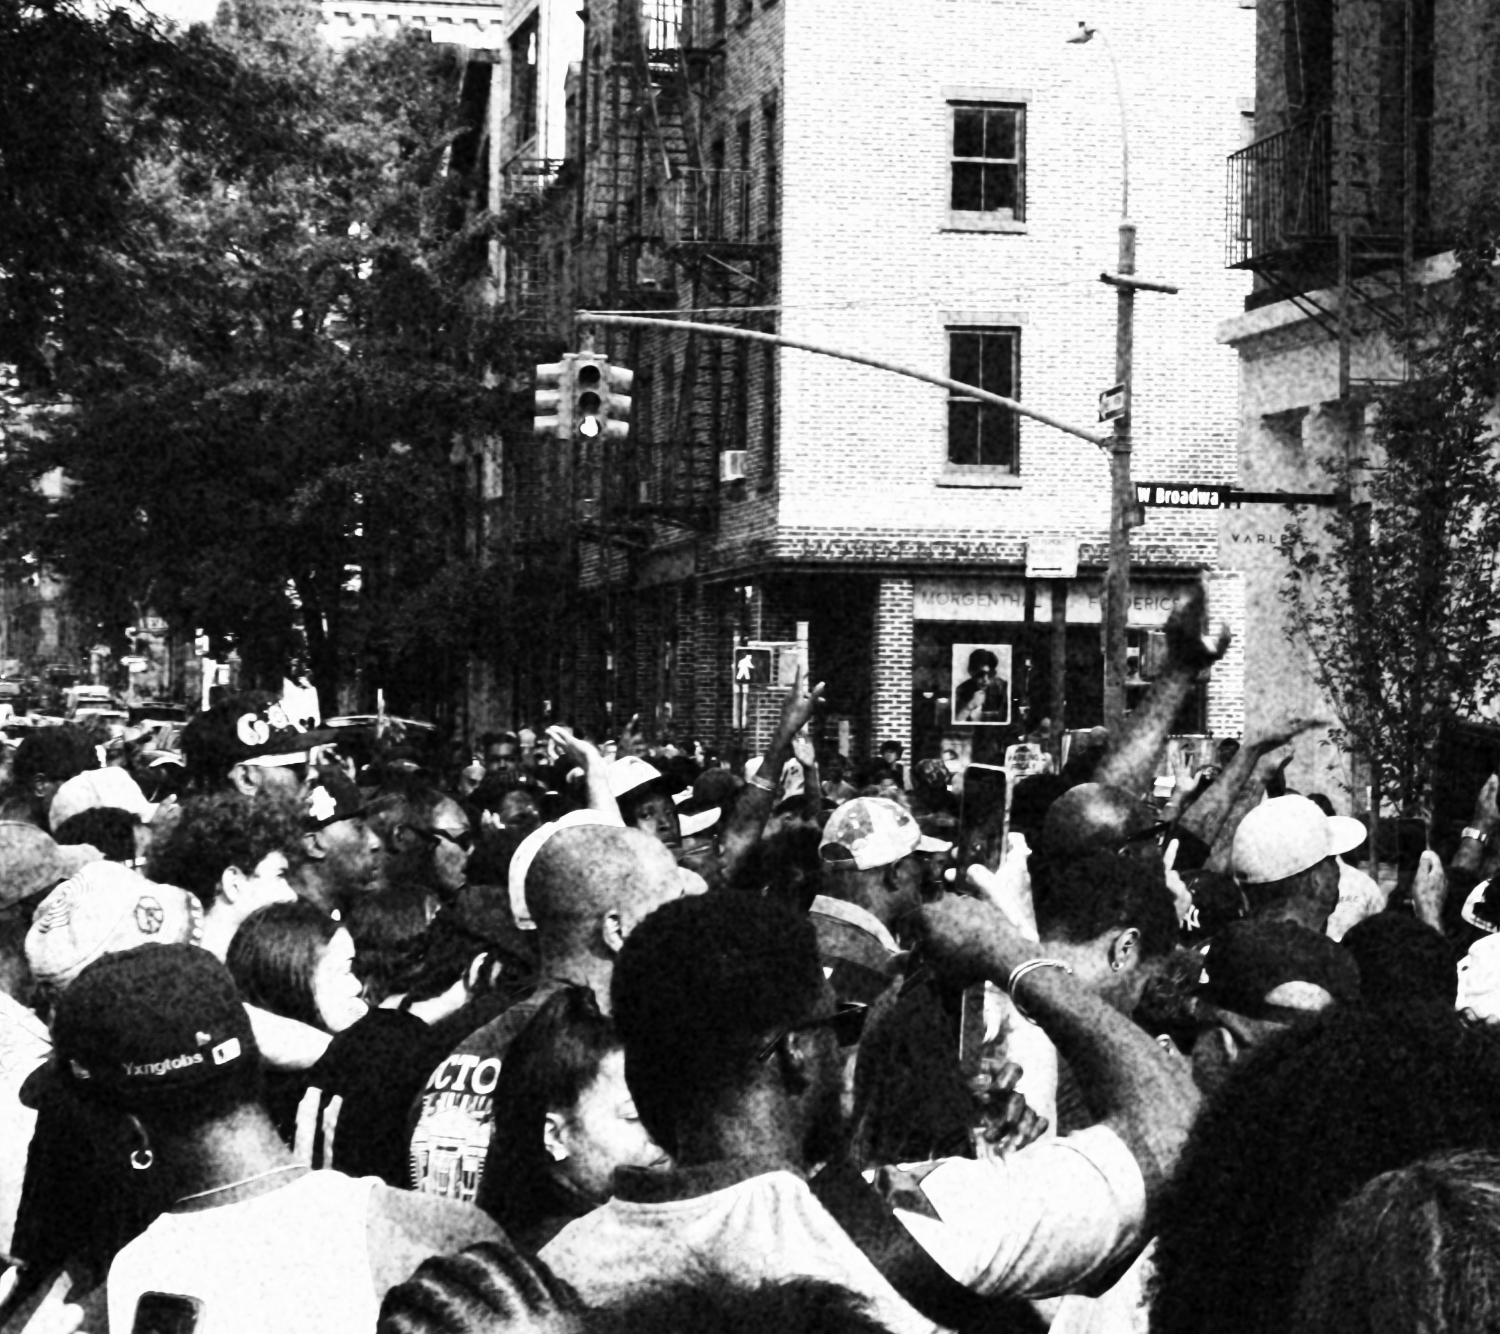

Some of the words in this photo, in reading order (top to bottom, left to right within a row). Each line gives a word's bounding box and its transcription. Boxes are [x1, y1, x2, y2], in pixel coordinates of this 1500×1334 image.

[1137, 486, 1151, 503] W
[1156, 487, 1225, 509] Broadwa
[1231, 533, 1289, 543] VARLE
[922, 592, 1043, 609] MORGENTH
